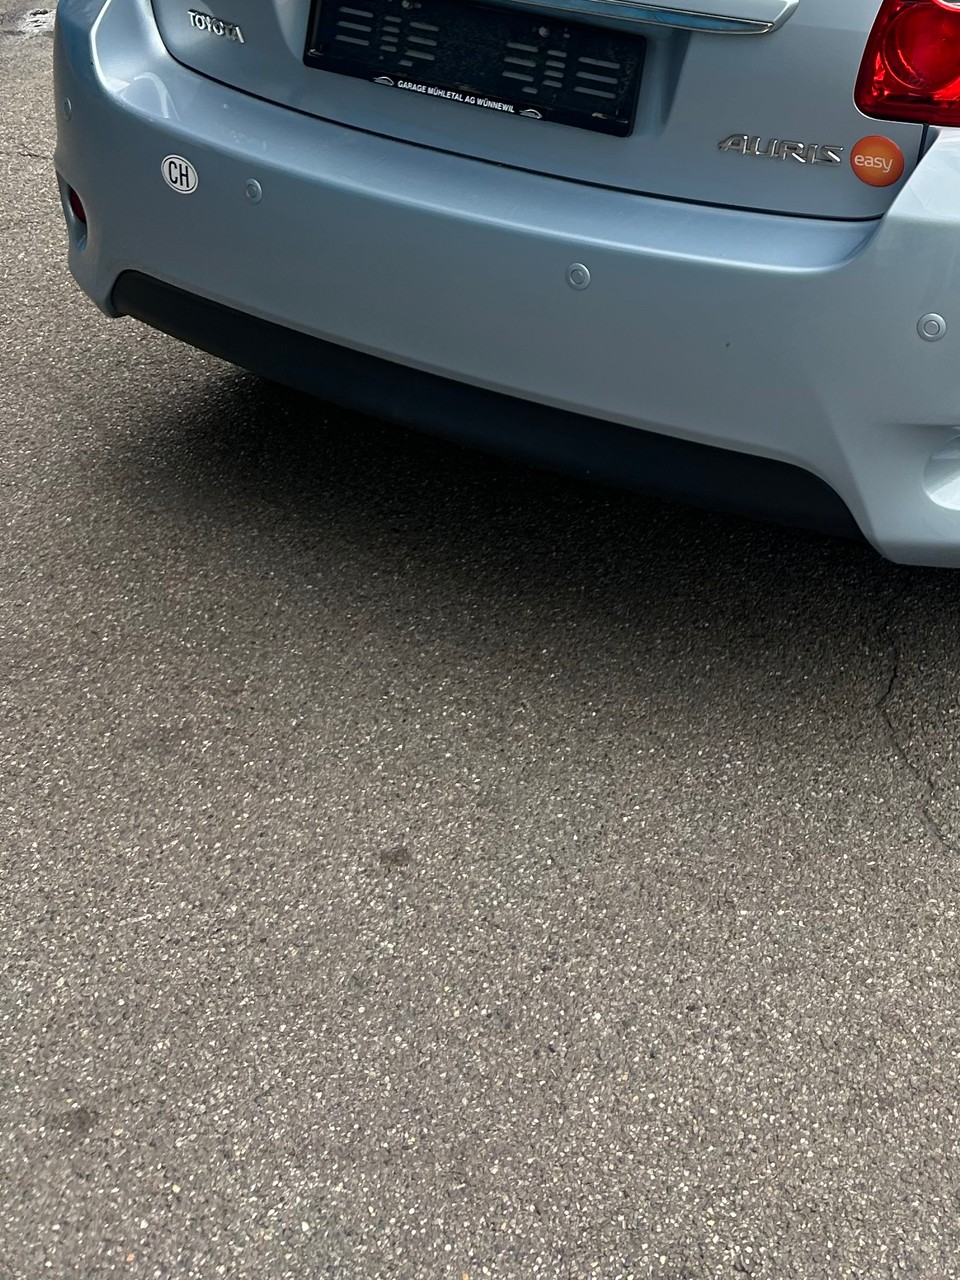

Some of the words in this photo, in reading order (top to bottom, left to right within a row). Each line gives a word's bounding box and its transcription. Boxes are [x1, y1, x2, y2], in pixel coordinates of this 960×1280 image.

[187, 9, 245, 44] TOYOTA
[397, 80, 427, 93] GARAGE
[427, 86, 464, 102] MÜHLETAL
[464, 95, 476, 105] AG
[476, 97, 515, 113] WÜNNEWIL
[718, 133, 844, 167] AURIS
[854, 153, 893, 173] easy
[168, 161, 190, 188] CH
